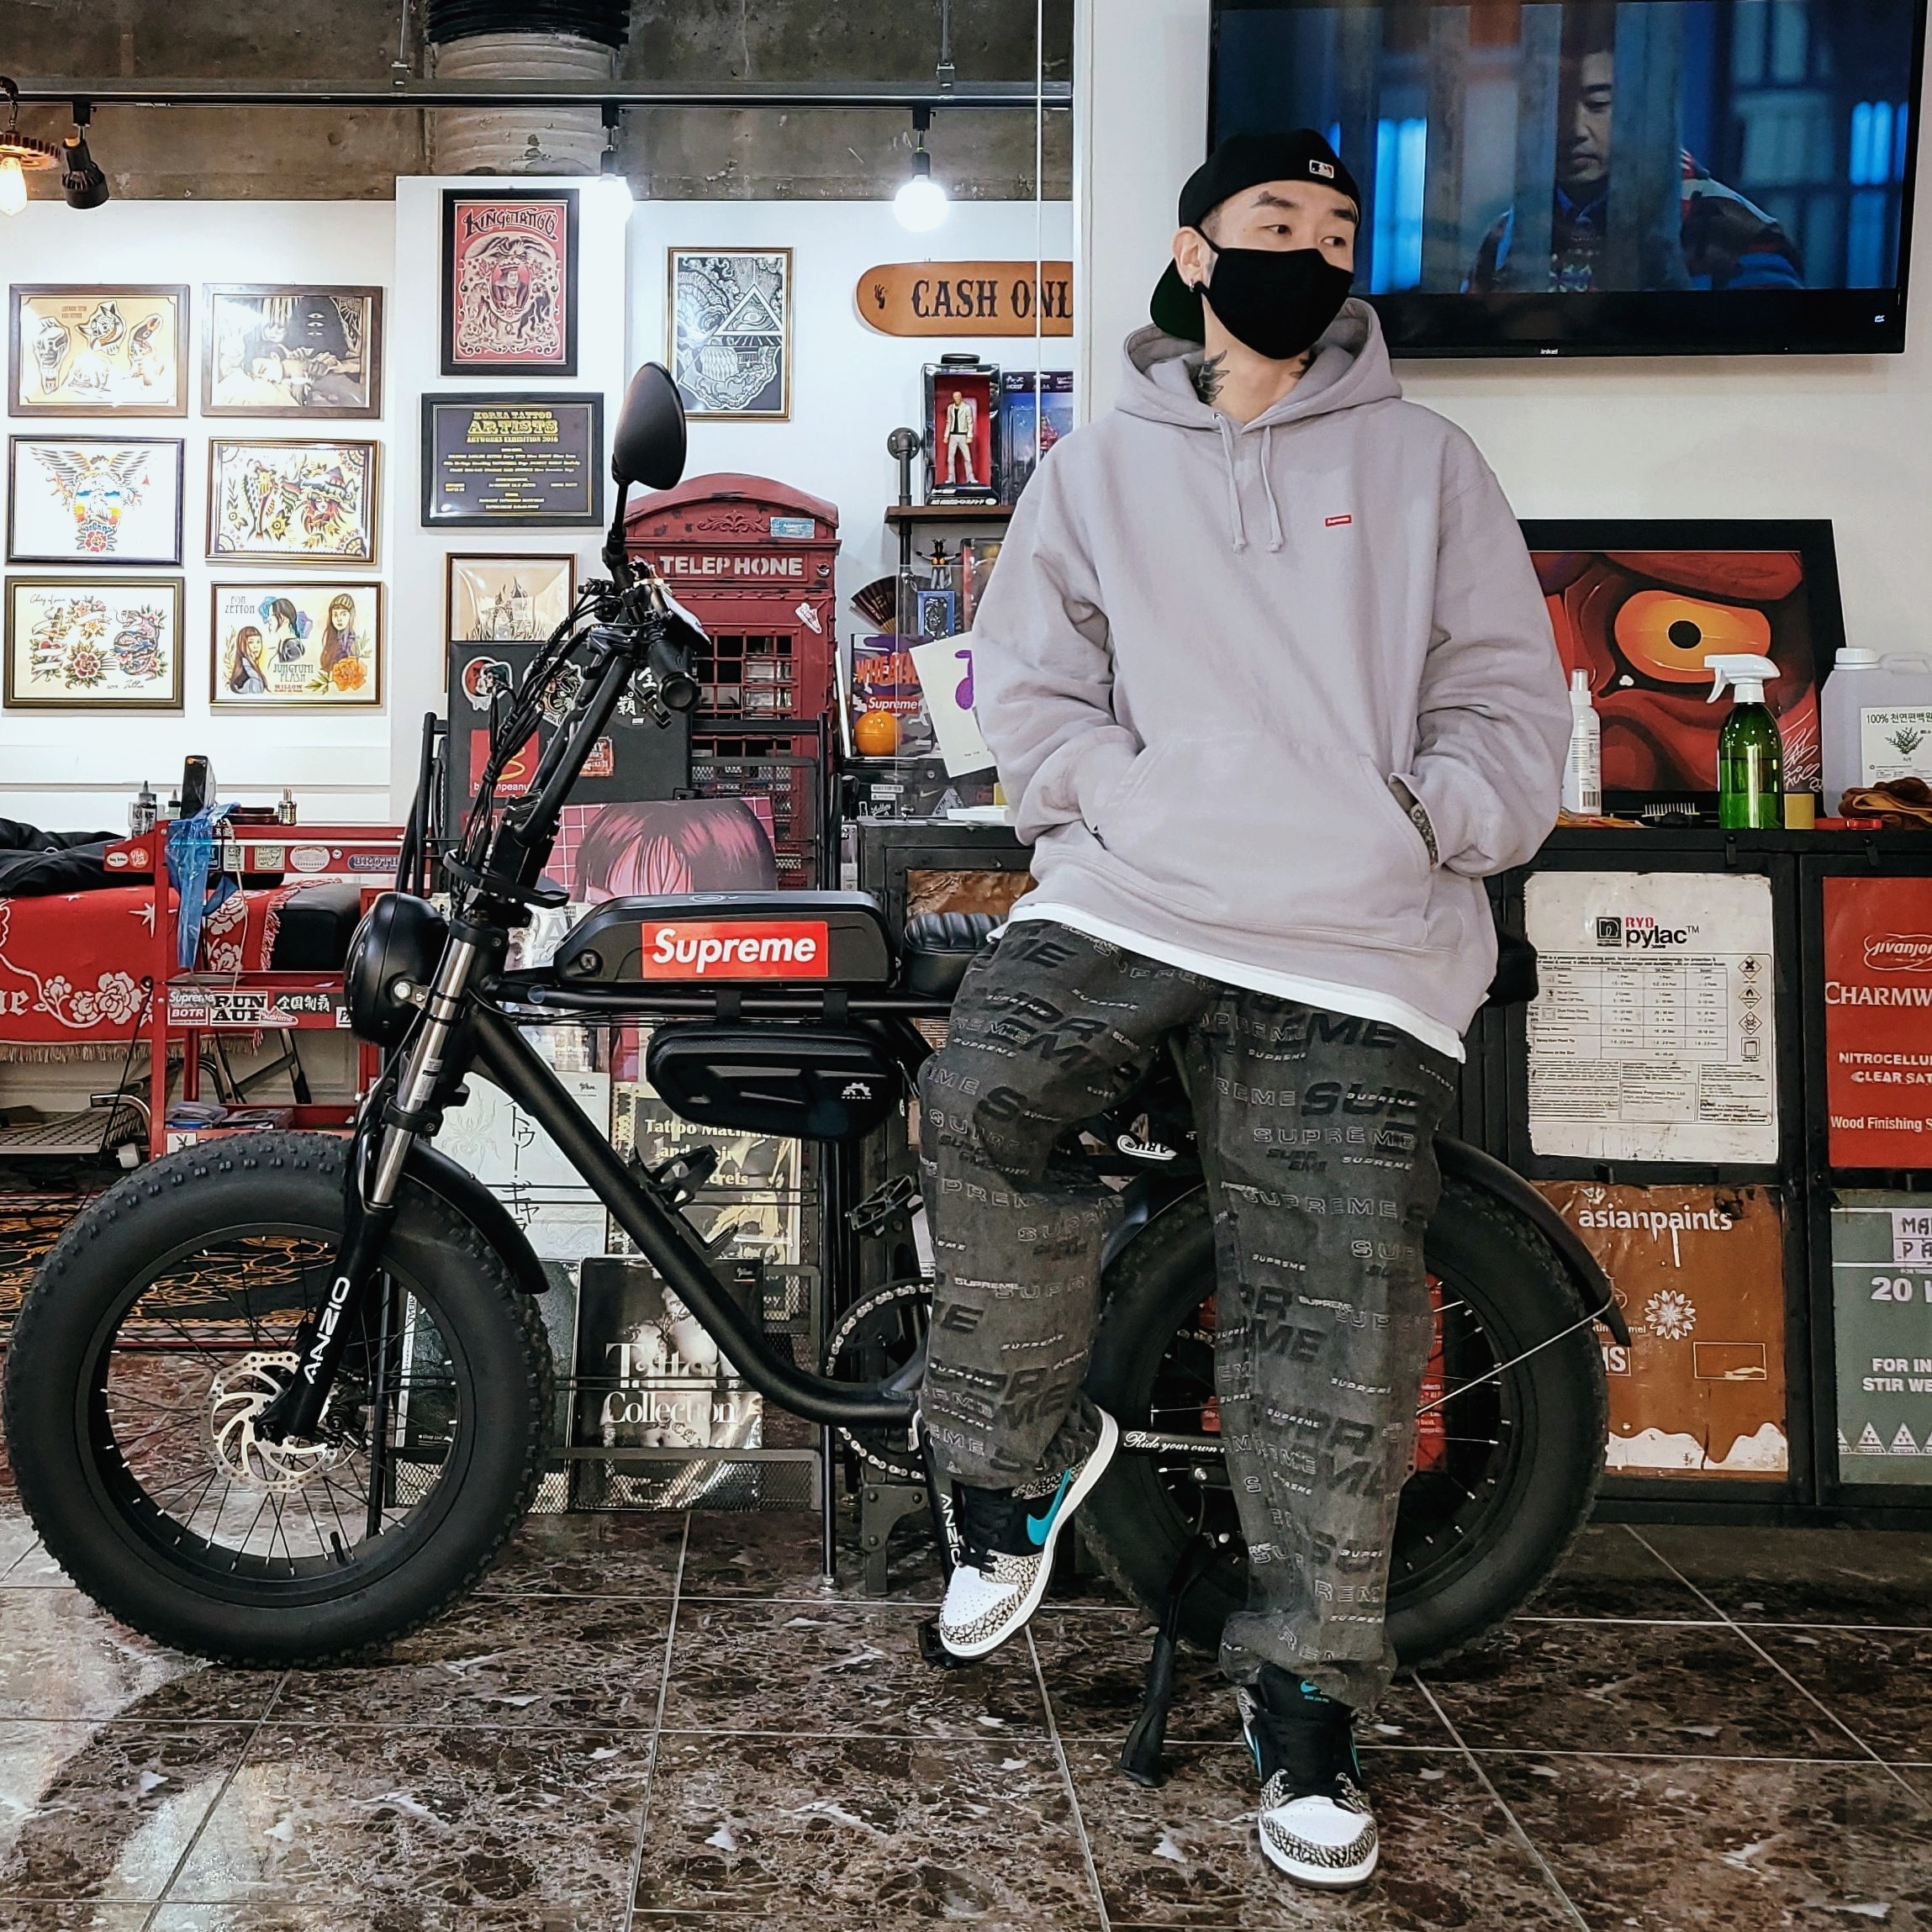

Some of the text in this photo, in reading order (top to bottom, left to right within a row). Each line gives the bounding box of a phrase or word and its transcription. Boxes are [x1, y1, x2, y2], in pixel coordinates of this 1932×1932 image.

[911, 280, 999, 318] CASH
[512, 411, 552, 420] TATTOO
[467, 420, 558, 434] ARTISTS
[868, 697, 918, 710] Supreme
[1866, 714, 1889, 724] 100%
[1626, 926, 1687, 948] pylac
[652, 928, 817, 974] Supreme
[215, 995, 267, 1009] RUN
[986, 995, 1050, 1017] SUPREME
[1072, 989, 1139, 1010] SUPREME
[953, 1037, 1016, 1058] SUPREME
[1248, 1048, 1306, 1061] SUPREME
[1854, 1071, 1902, 1083] CLEAR
[1346, 1093, 1417, 1107] SUPREME
[1830, 1116, 1864, 1129] Wood
[1867, 1116, 1922, 1132] Finishing
[1254, 1127, 1415, 1150] SUPREME
[1342, 1156, 1412, 1172] SUPREME
[1578, 1203, 1733, 1234] asianpaints
[1252, 1254, 1306, 1271] SUPREME
[955, 1277, 1023, 1291] SUPREME
[1871, 1276, 1913, 1302] 20
[304, 1276, 351, 1385] ANZIO
[1001, 1334, 1064, 1350] SUPREME
[1872, 1358, 1908, 1372] FOR
[929, 1362, 995, 1386] SUPREME
[1862, 1377, 1904, 1391] STIR
[606, 1391, 738, 1424] Collection
[1267, 1408, 1320, 1428] SUPREME
[1123, 1431, 1160, 1449] Ride
[1159, 1442, 1190, 1454] your
